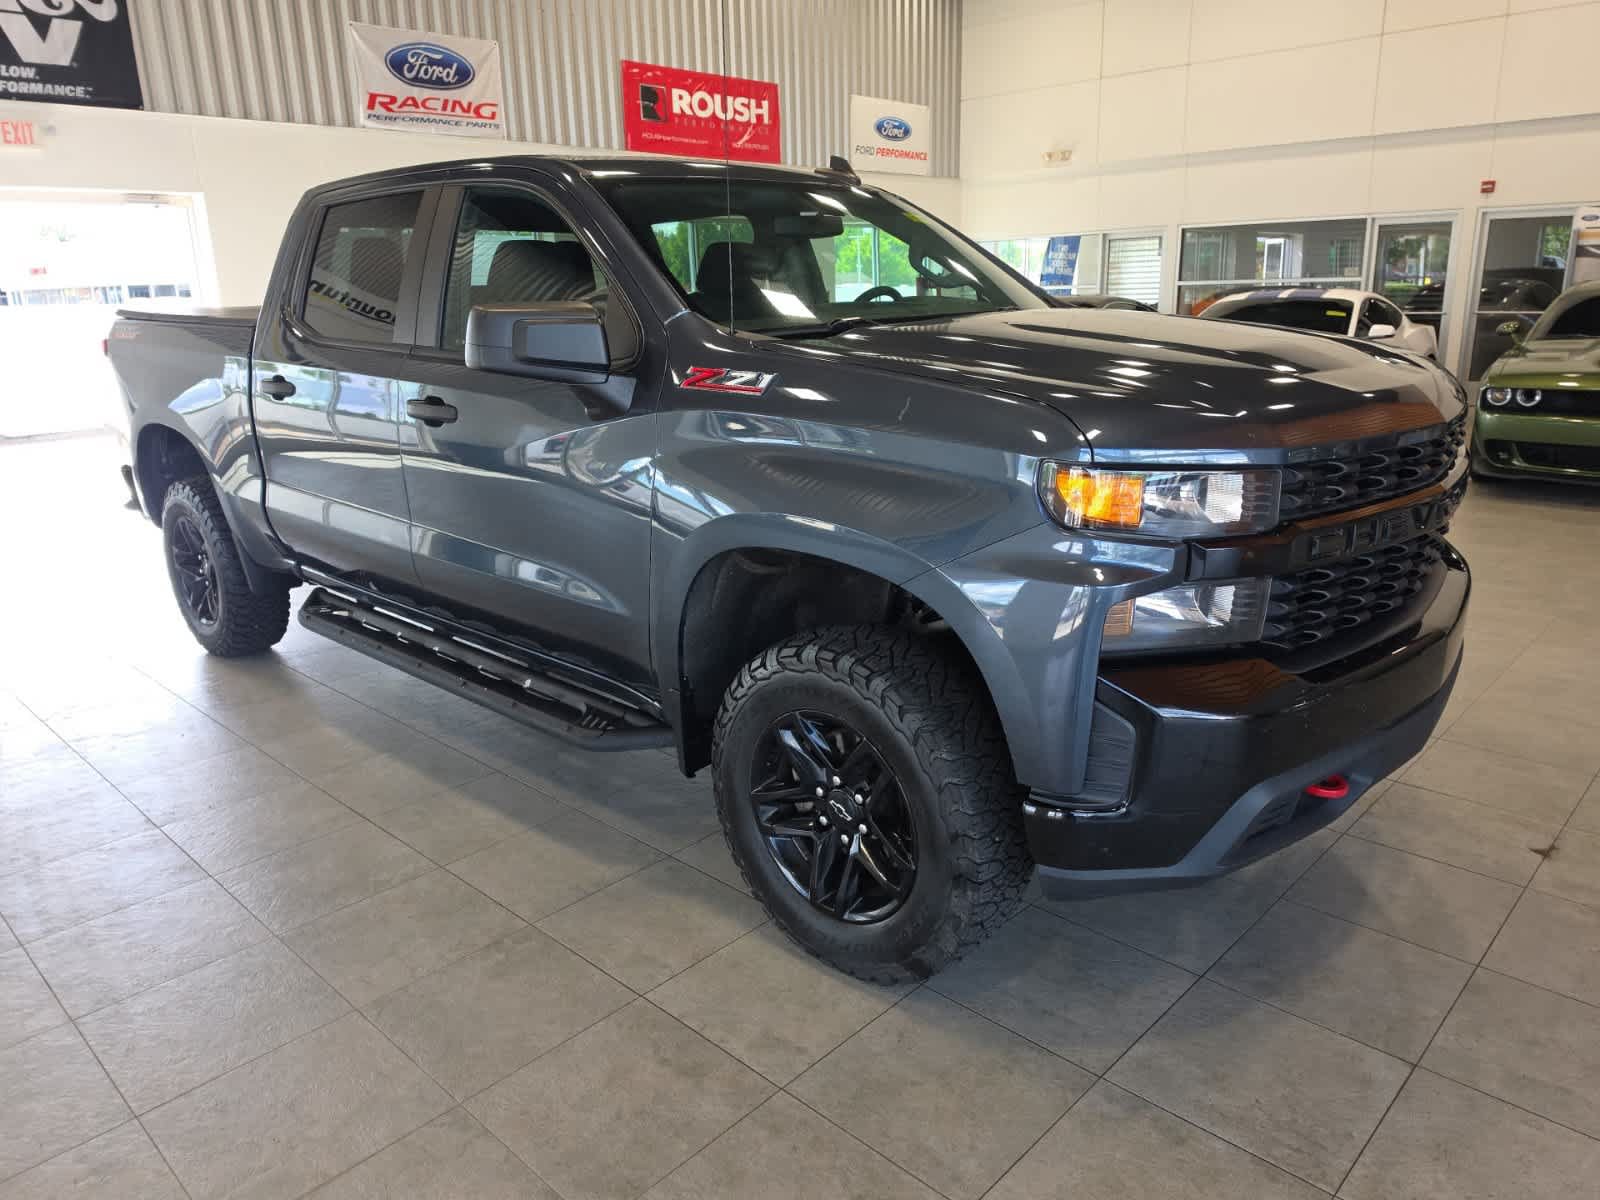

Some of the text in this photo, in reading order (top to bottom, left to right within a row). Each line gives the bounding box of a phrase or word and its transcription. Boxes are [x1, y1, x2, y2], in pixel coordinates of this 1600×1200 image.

[403, 49, 458, 83] Ford
[367, 92, 499, 120] RACING
[671, 87, 769, 125] ROUSH
[0, 120, 34, 145] EXIT
[367, 113, 500, 129] PERFORMANCE PARTS
[881, 120, 905, 137] Ford
[856, 145, 928, 160] FORD PERFORMANCE
[680, 366, 778, 396] Z71
